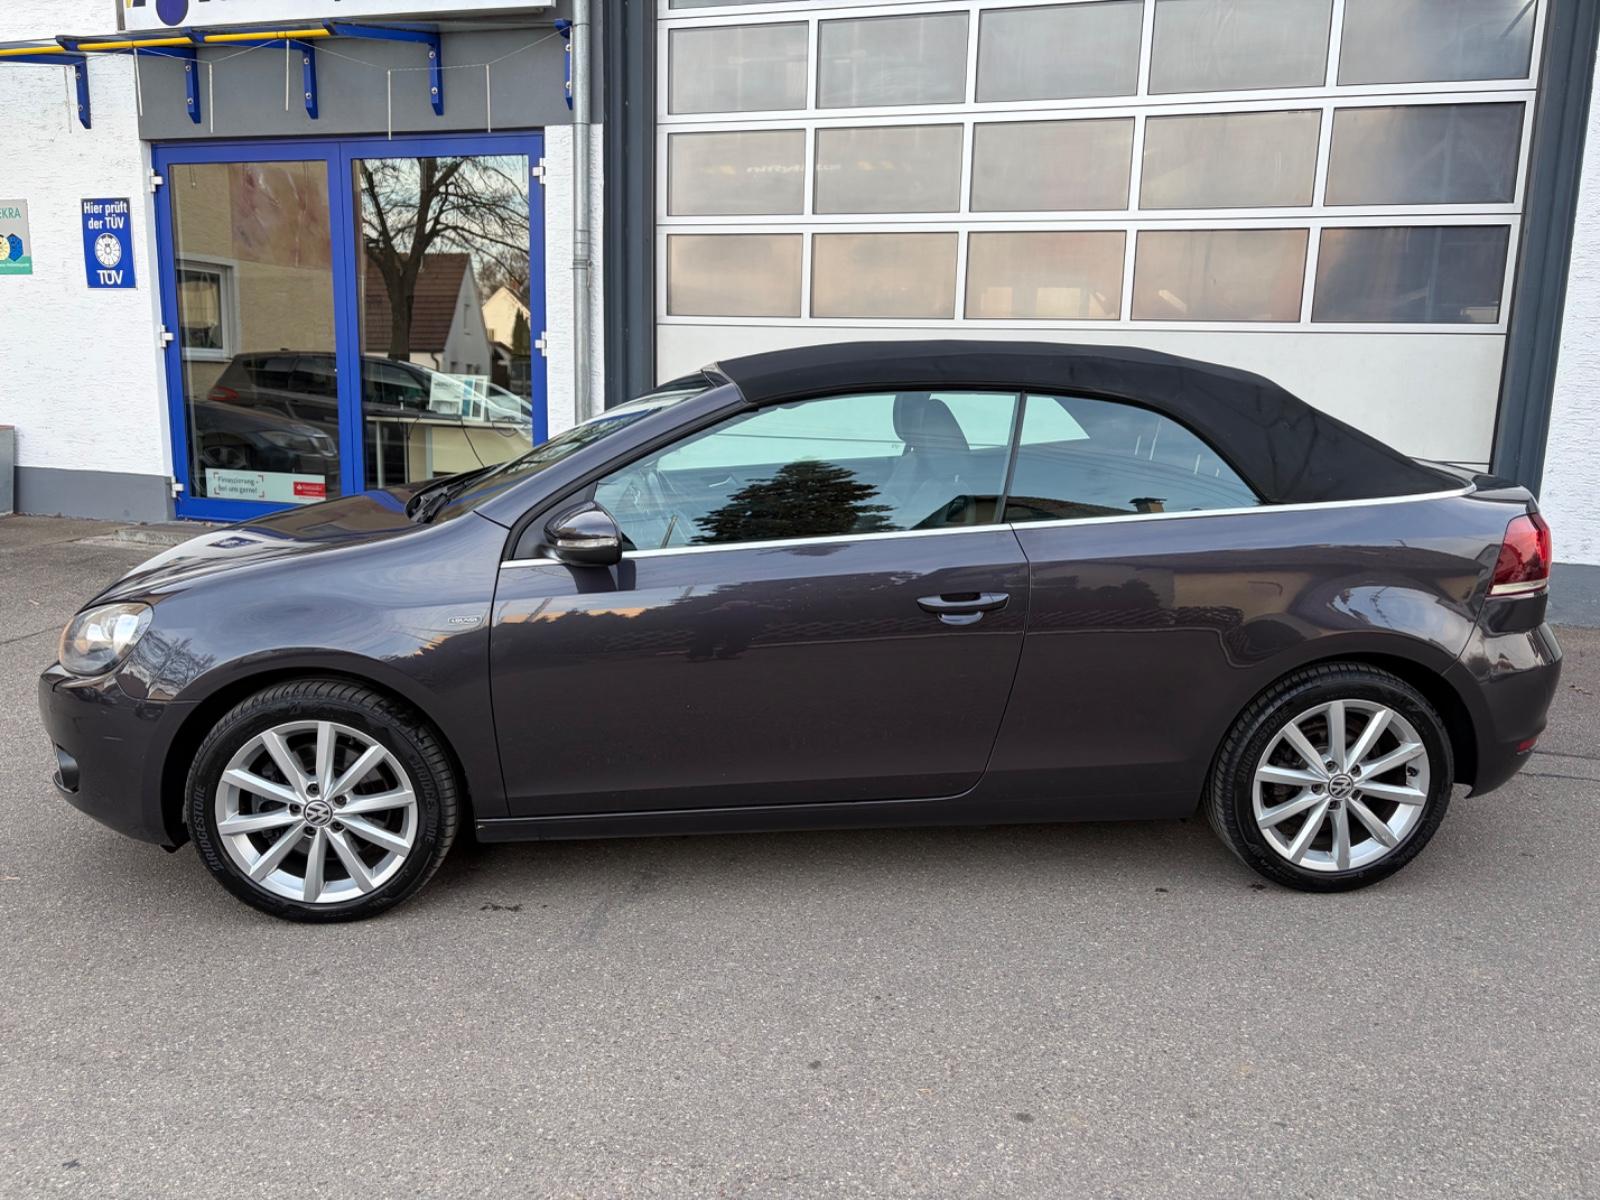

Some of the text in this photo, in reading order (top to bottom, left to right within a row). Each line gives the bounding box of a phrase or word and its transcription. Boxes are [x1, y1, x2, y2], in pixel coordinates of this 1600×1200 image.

[84, 201, 128, 217] Hier prüft
[88, 214, 125, 230] der TÜV
[96, 270, 124, 285] TÜV
[194, 784, 224, 871] BRIDGESTONE
